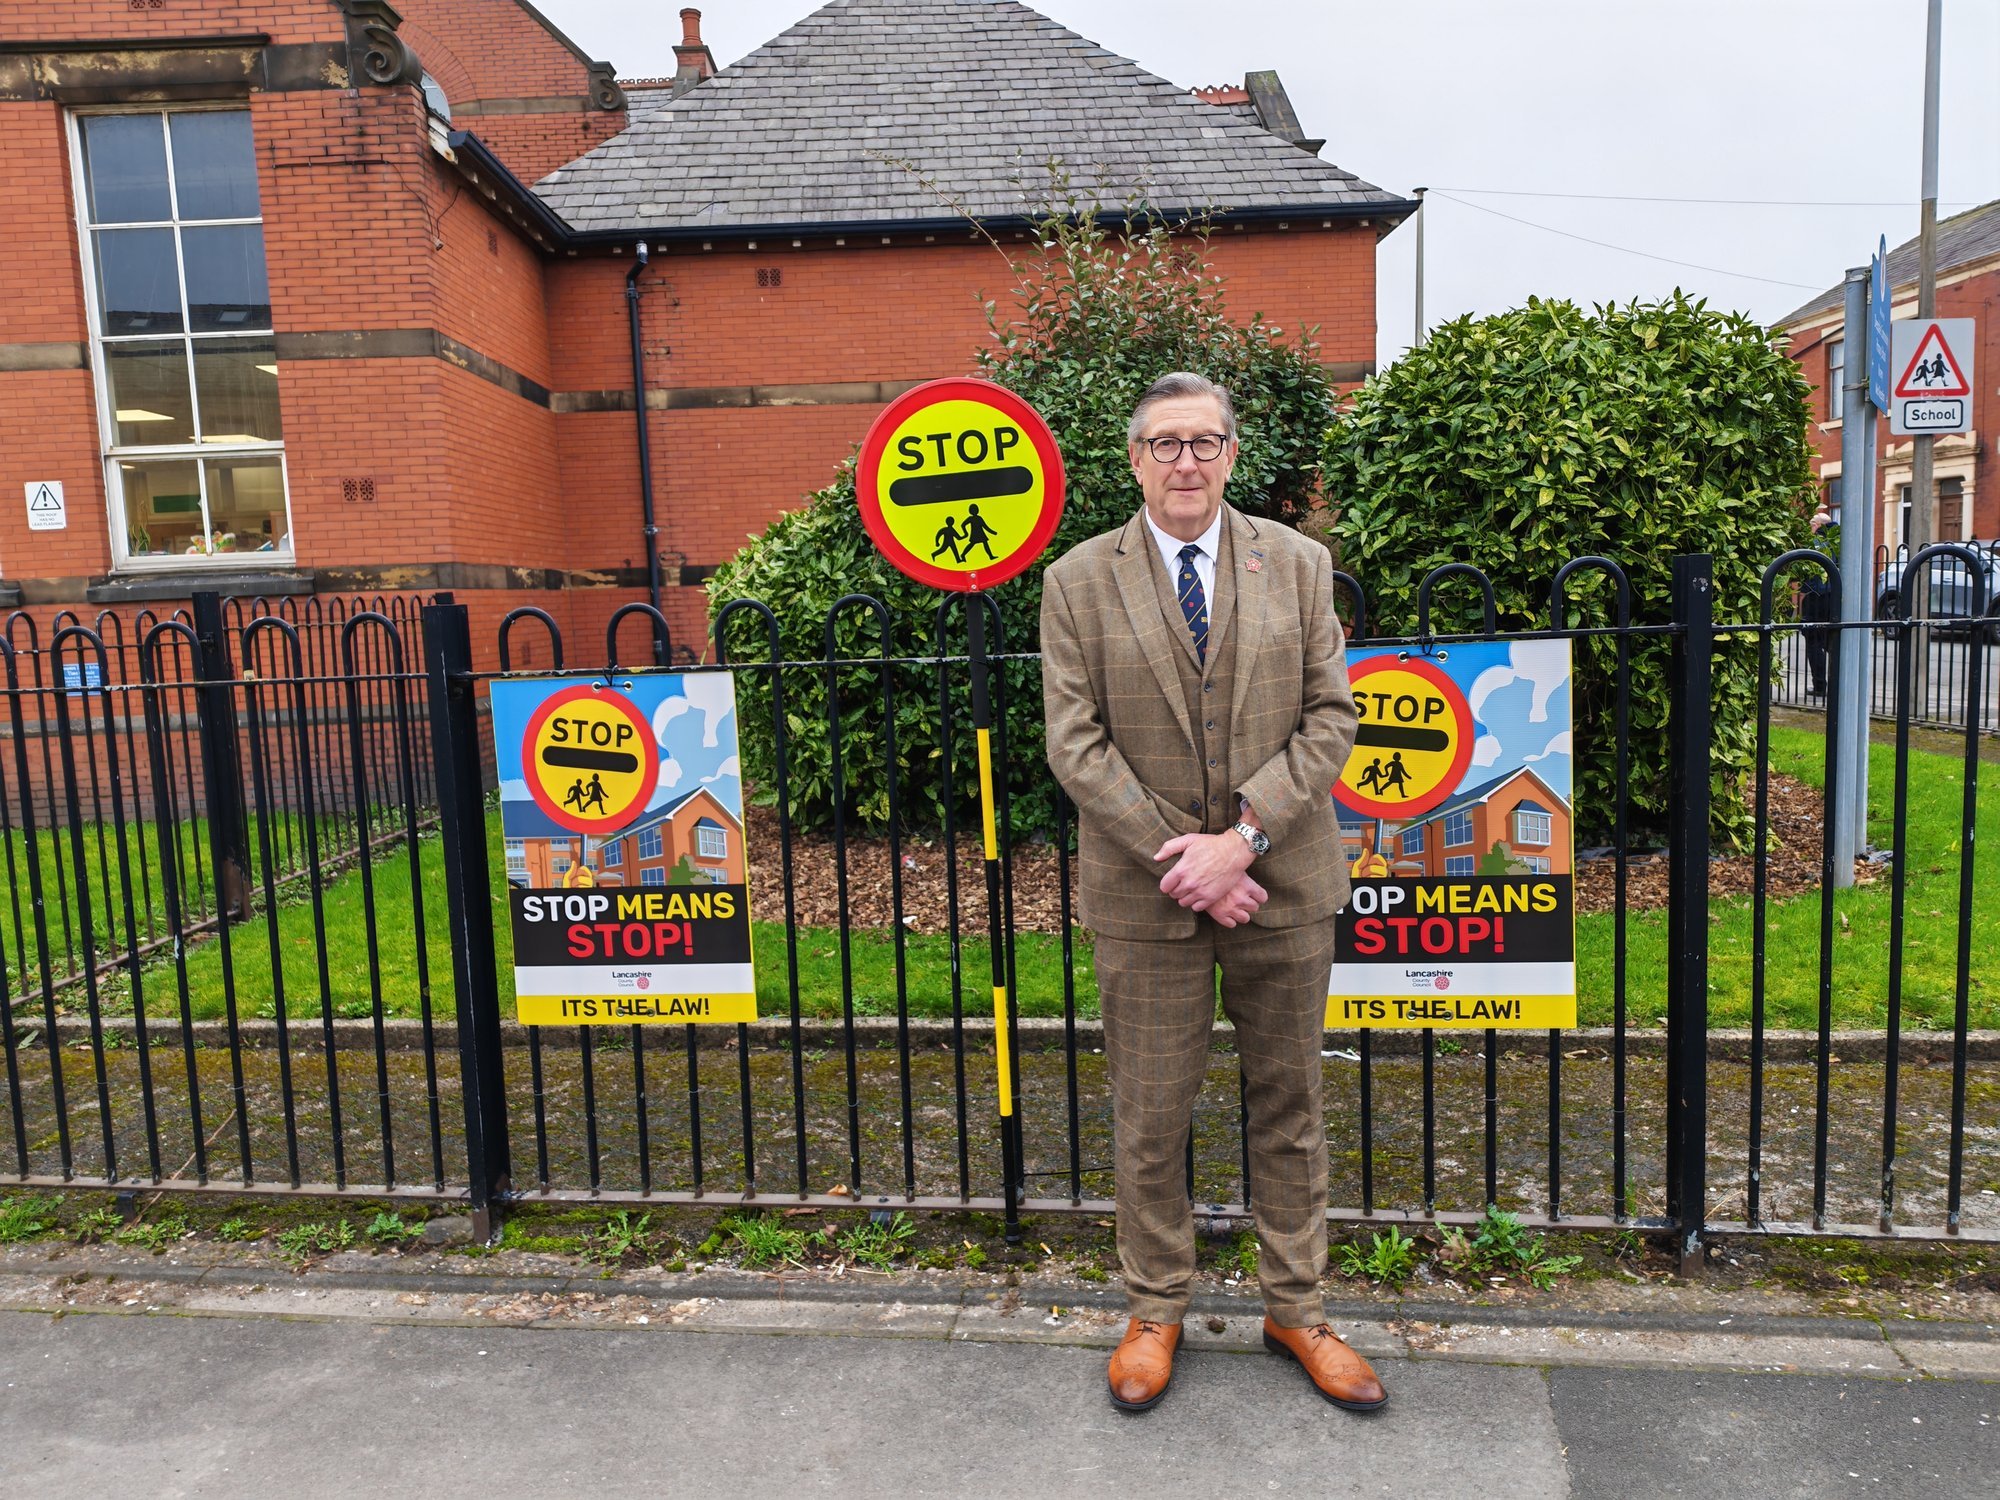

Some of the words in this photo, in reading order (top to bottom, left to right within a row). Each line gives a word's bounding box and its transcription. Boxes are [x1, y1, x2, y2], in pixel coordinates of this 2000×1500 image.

[1912, 408, 1956, 420] School
[897, 426, 1019, 471] STOP
[551, 717, 633, 748] STOP
[523, 895, 609, 922] STOP
[617, 892, 735, 920] MEANS
[1336, 886, 1405, 914] OP
[1416, 883, 1557, 914] MEANS
[567, 922, 694, 957] STOP!
[1354, 916, 1504, 955] STOP!
[1405, 969, 1453, 977] Lancashire
[562, 999, 597, 1016] ITS
[602, 999, 648, 1016] THE
[655, 998, 710, 1016] LAW!
[1344, 1000, 1386, 1019] ITS
[1392, 1000, 1447, 1019] THE
[1456, 1000, 1521, 1019] LAW!
